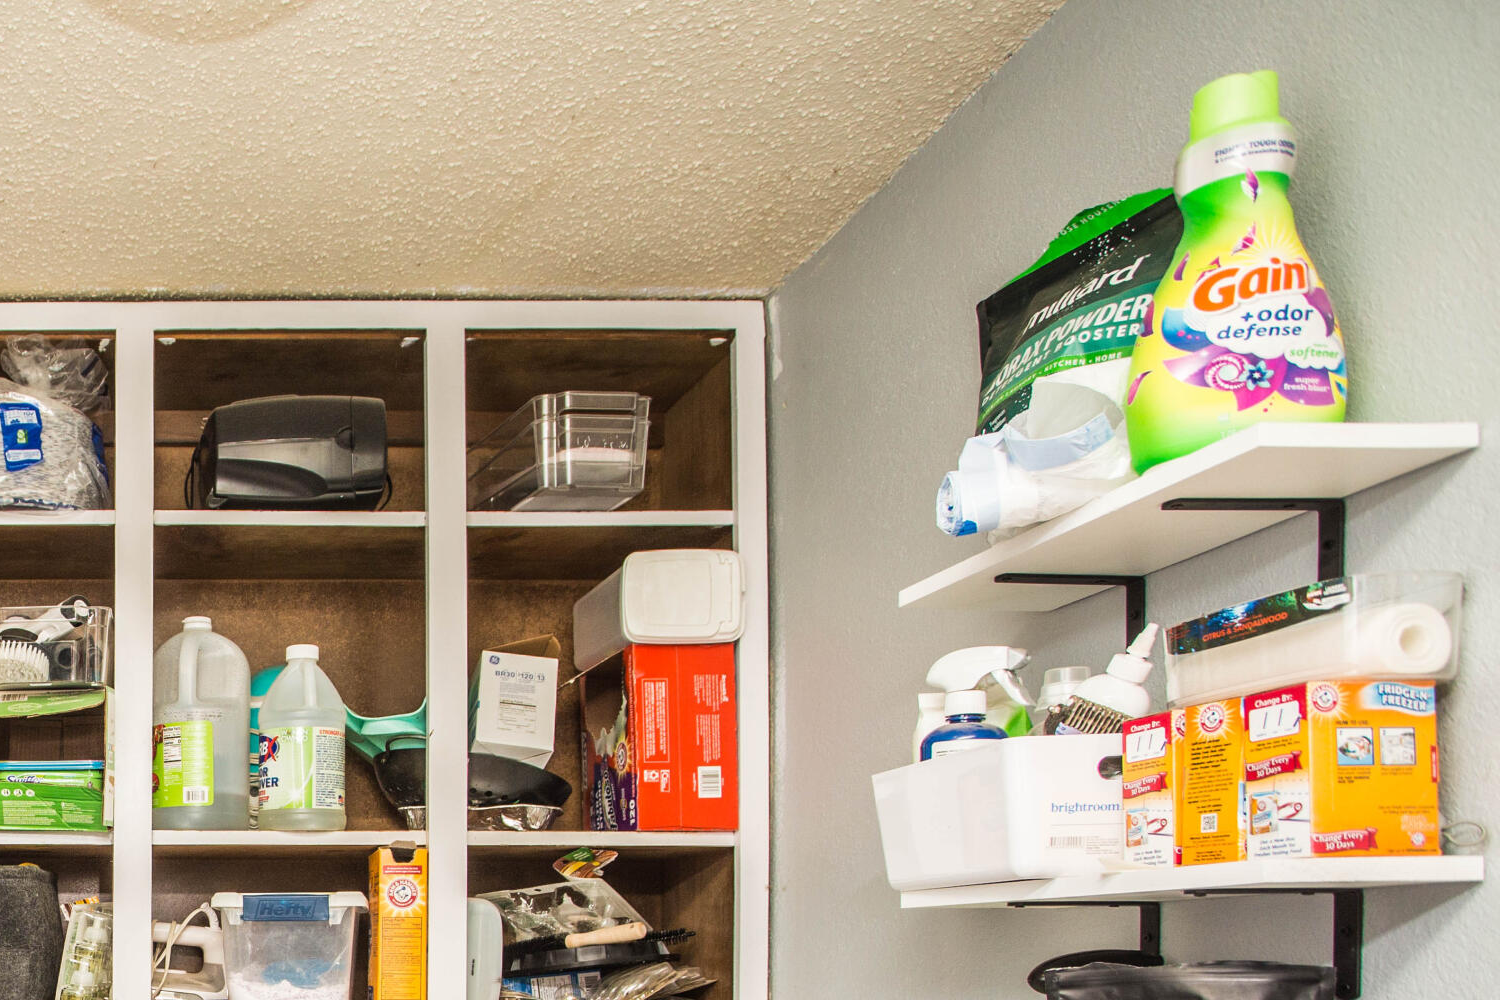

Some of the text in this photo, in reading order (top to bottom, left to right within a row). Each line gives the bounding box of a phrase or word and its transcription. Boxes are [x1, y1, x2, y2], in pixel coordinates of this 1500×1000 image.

[1027, 252, 1152, 329] milliard
[1193, 256, 1307, 312] Gain
[1043, 293, 1153, 350] POWDER
[1217, 323, 1302, 341] defense
[1290, 346, 1340, 360] softener
[1044, 358, 1086, 373] KITCHEN
[1095, 352, 1122, 363] HOME
[1202, 629, 1226, 643] CITRUS
[1233, 611, 1289, 634] SANDALWOOD
[1255, 697, 1281, 709] Change
[1382, 695, 1428, 712] FREEZER
[1130, 723, 1151, 734] Change
[1247, 757, 1290, 772] Change Every
[1265, 766, 1282, 776] Days
[1123, 774, 1158, 790] Change Every
[1138, 785, 1151, 795] Days
[1051, 802, 1120, 814] brightroom
[1313, 830, 1364, 844] Change Every
[1337, 840, 1354, 849] Days
[258, 900, 312, 916] Hefty
